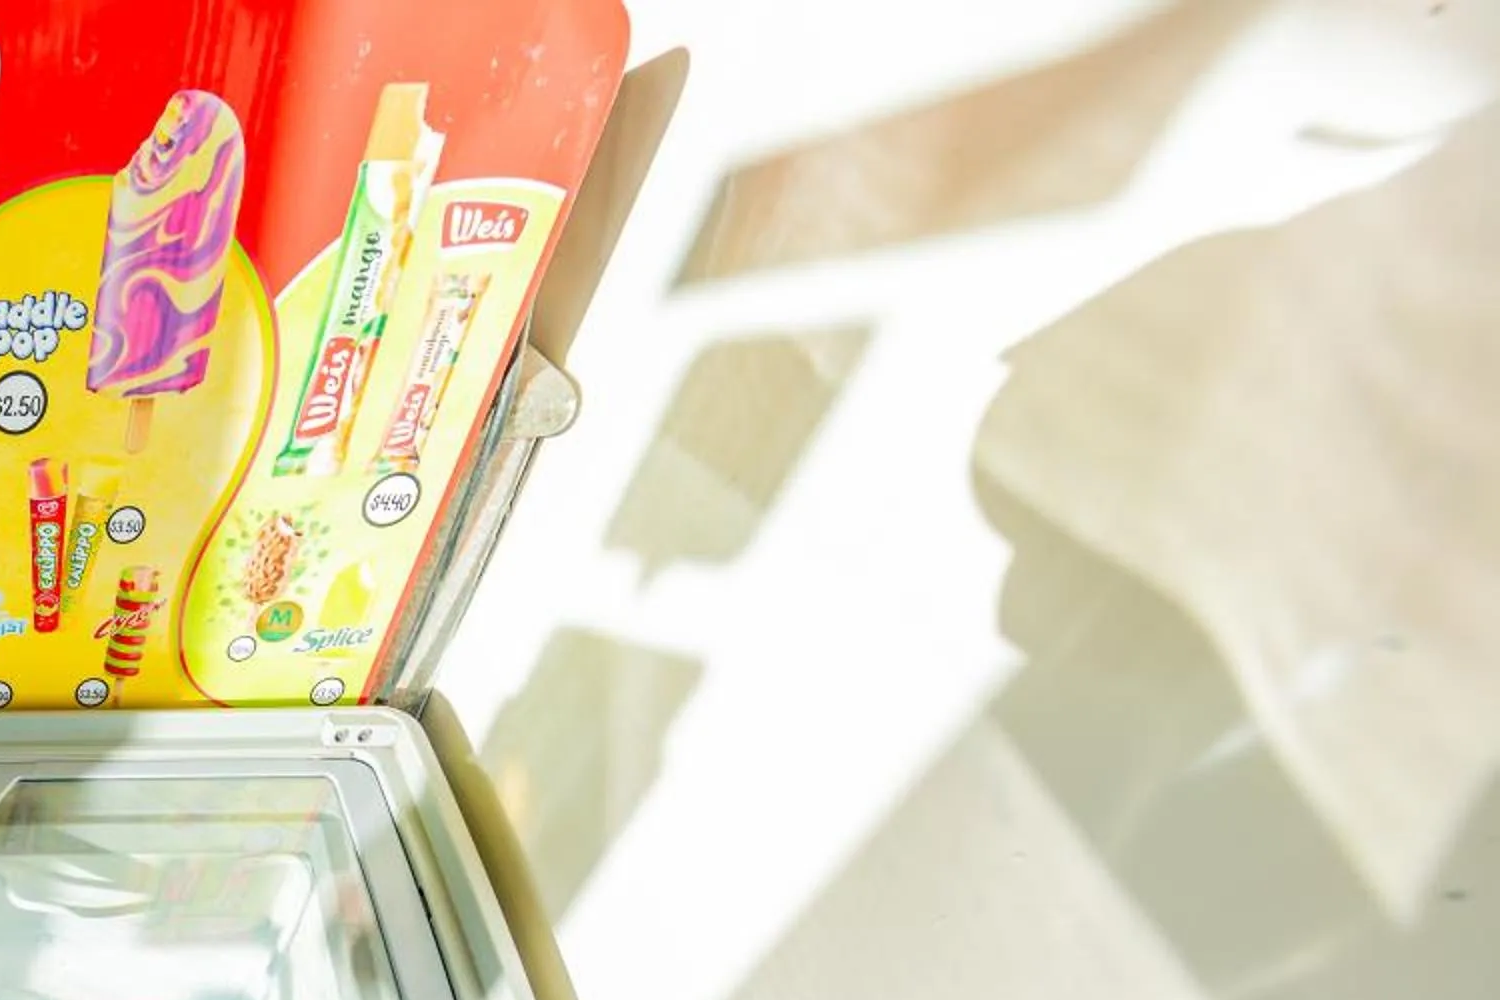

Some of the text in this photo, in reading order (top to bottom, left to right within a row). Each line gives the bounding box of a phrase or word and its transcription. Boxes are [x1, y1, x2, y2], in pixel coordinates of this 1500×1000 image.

[450, 204, 516, 242] Weis
[342, 232, 382, 326] mango
[303, 348, 350, 432] Weis
[385, 388, 428, 451] Weis
[369, 493, 412, 513] $4.40
[292, 626, 374, 653] Splice
